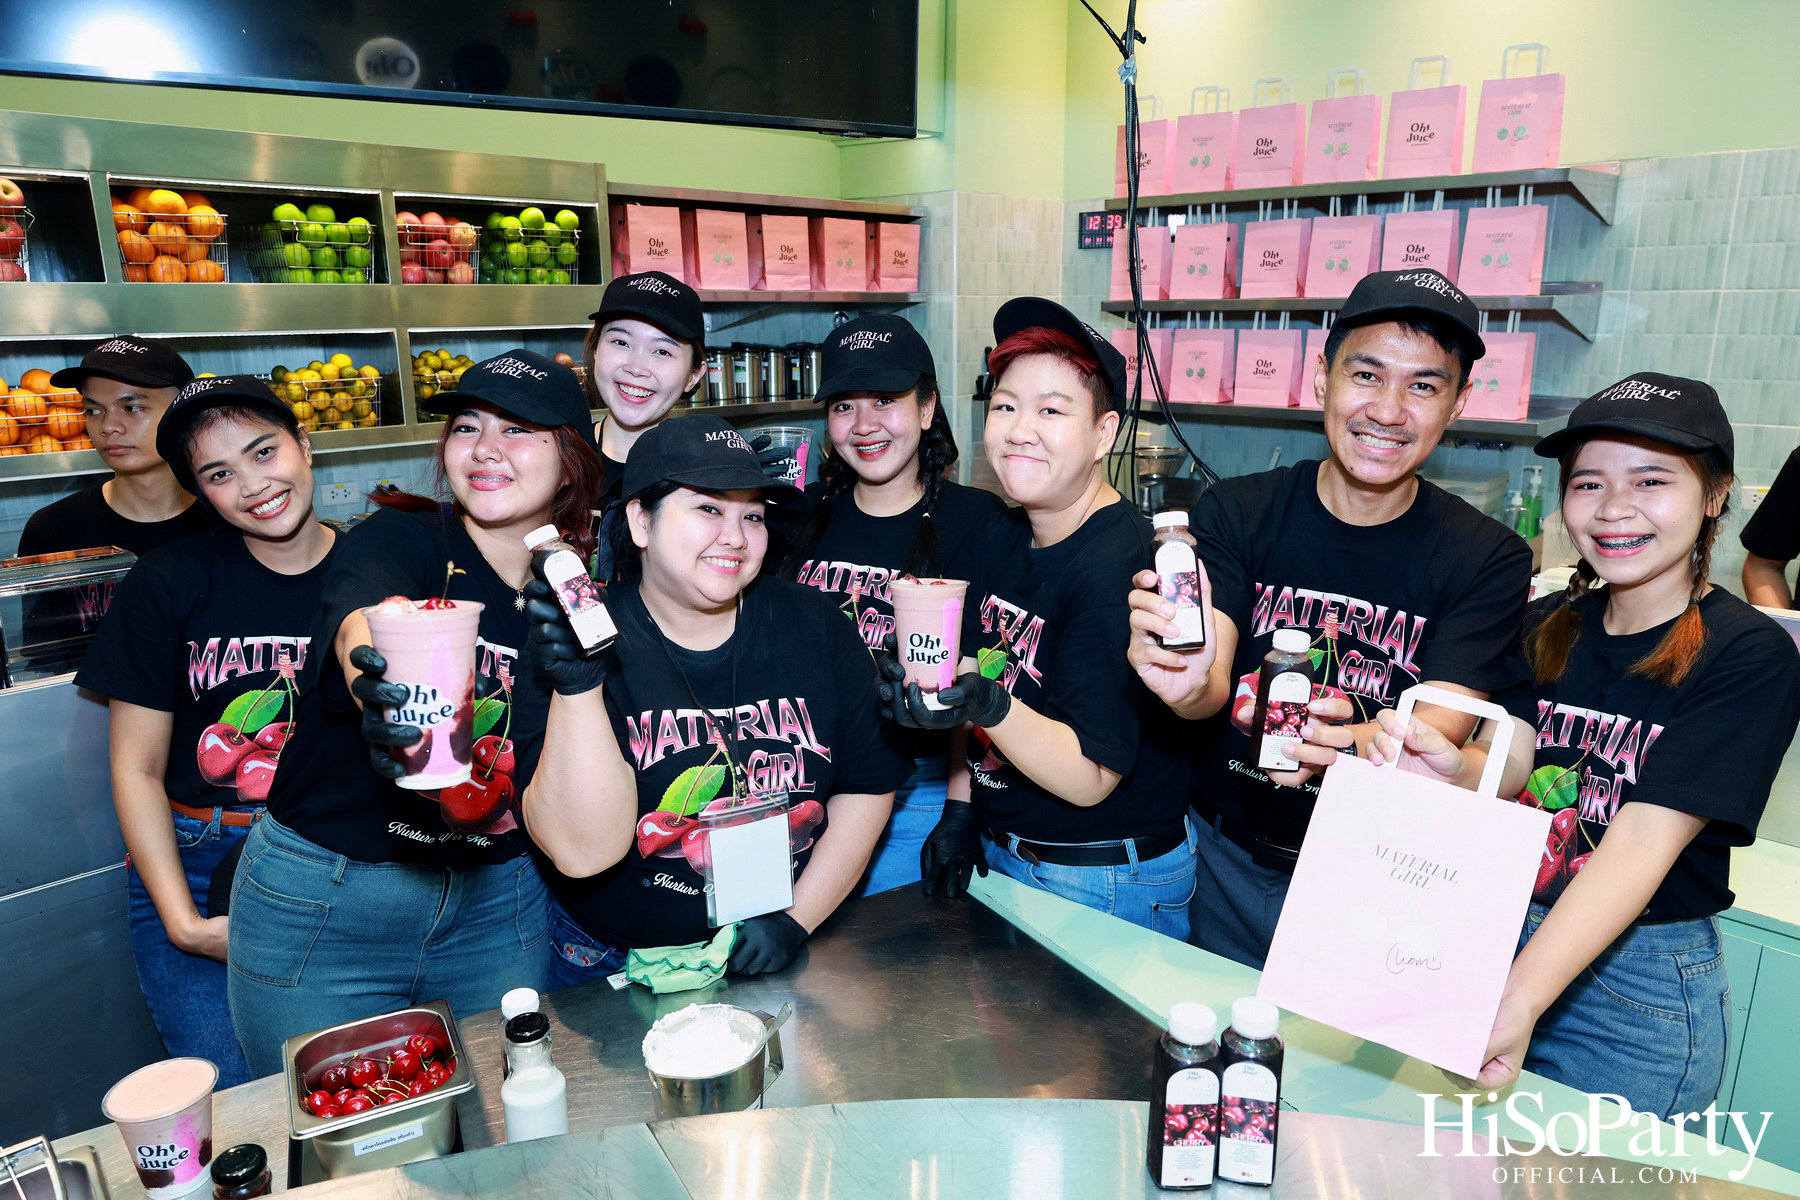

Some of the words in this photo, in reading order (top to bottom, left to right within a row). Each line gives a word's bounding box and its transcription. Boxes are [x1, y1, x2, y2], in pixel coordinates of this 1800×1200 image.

[1410, 123, 1430, 133] Oh!
[1256, 138, 1273, 147] Oh!
[1406, 131, 1435, 143] Juice
[1253, 145, 1278, 156] Juice
[1088, 215, 1122, 230] 12:39
[649, 238, 664, 248] Oh!
[780, 245, 794, 253] Oh!
[1406, 244, 1425, 254] Oh!
[647, 247, 669, 257] Juice
[779, 253, 798, 261] Juice
[894, 250, 905, 258] Oh!
[1263, 250, 1279, 259] Oh!
[1402, 252, 1430, 263] Juice
[893, 258, 908, 266] Juice
[1260, 258, 1284, 268] Juice
[627, 277, 680, 297] MATERIAL
[637, 282, 663, 295] GIRL
[1395, 273, 1463, 303] MATERIAL
[1414, 279, 1448, 297] GIRL
[838, 331, 893, 348] MATERIAL
[850, 340, 875, 350] GIRL
[482, 357, 548, 381] MATERIAL
[1256, 359, 1272, 368] Oh!
[491, 364, 523, 379] GIRL
[1253, 367, 1276, 376] Juice
[184, 384, 214, 400] GIRL
[1598, 379, 1682, 401] MATERIAL
[1611, 390, 1651, 401] GIRL
[1250, 582, 1427, 684] MATERIAL
[909, 633, 941, 649] Oh!
[907, 648, 949, 665] Juice
[1338, 649, 1396, 707] GIRL
[392, 703, 453, 725] Juice
[626, 697, 831, 771] MATERIAL
[748, 745, 816, 799] GIRL
[1228, 759, 1268, 782] Nurture
[388, 821, 435, 844] Nurture
[1371, 844, 1459, 883] MATERIAL
[653, 872, 699, 896] Nurture
[1390, 866, 1431, 890] GIRL
[1173, 1139, 1206, 1147] CHERRY
[1230, 1132, 1263, 1143] CHERRY
[137, 1144, 176, 1157] Oh!
[140, 1149, 190, 1169] Juice
